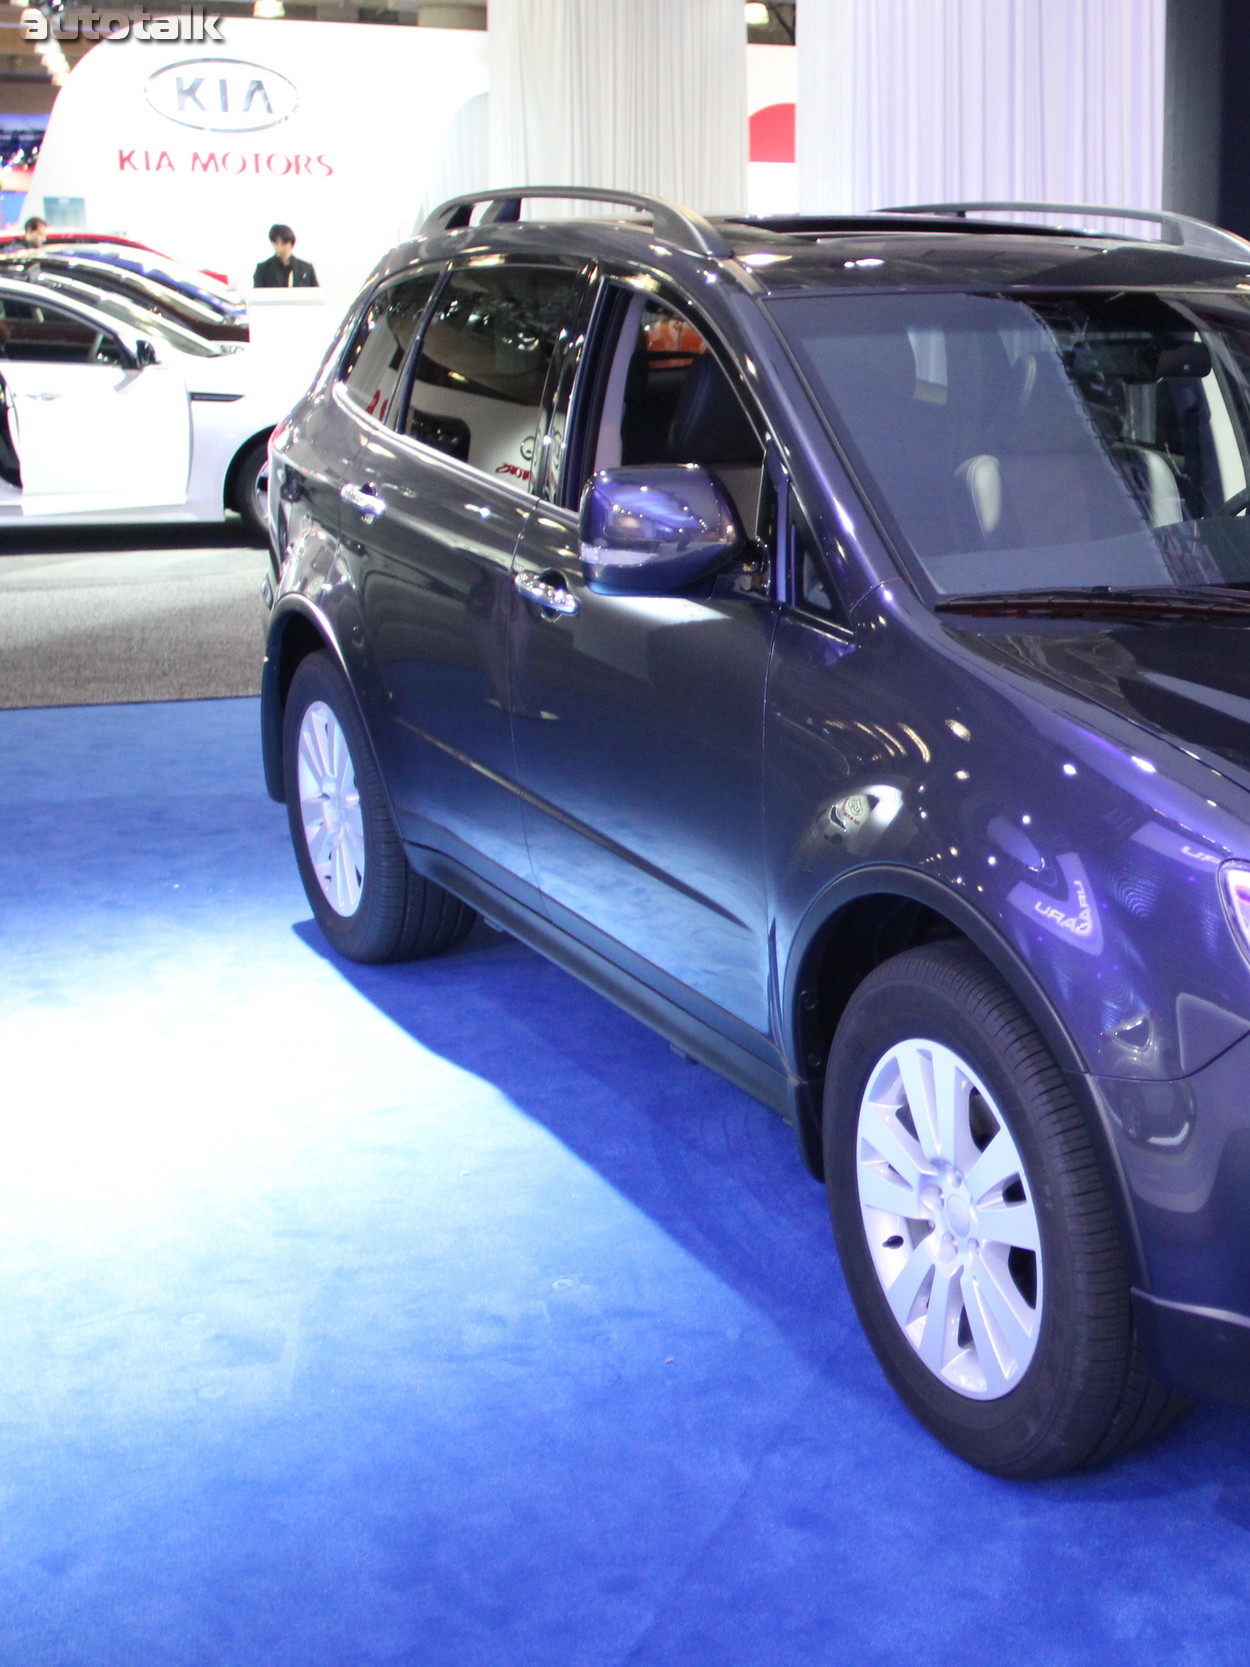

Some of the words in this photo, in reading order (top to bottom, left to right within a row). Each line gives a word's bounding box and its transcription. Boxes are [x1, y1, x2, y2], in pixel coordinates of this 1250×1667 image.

[175, 76, 274, 114] KIA
[118, 149, 175, 171] KIA
[191, 151, 334, 177] MOTORS
